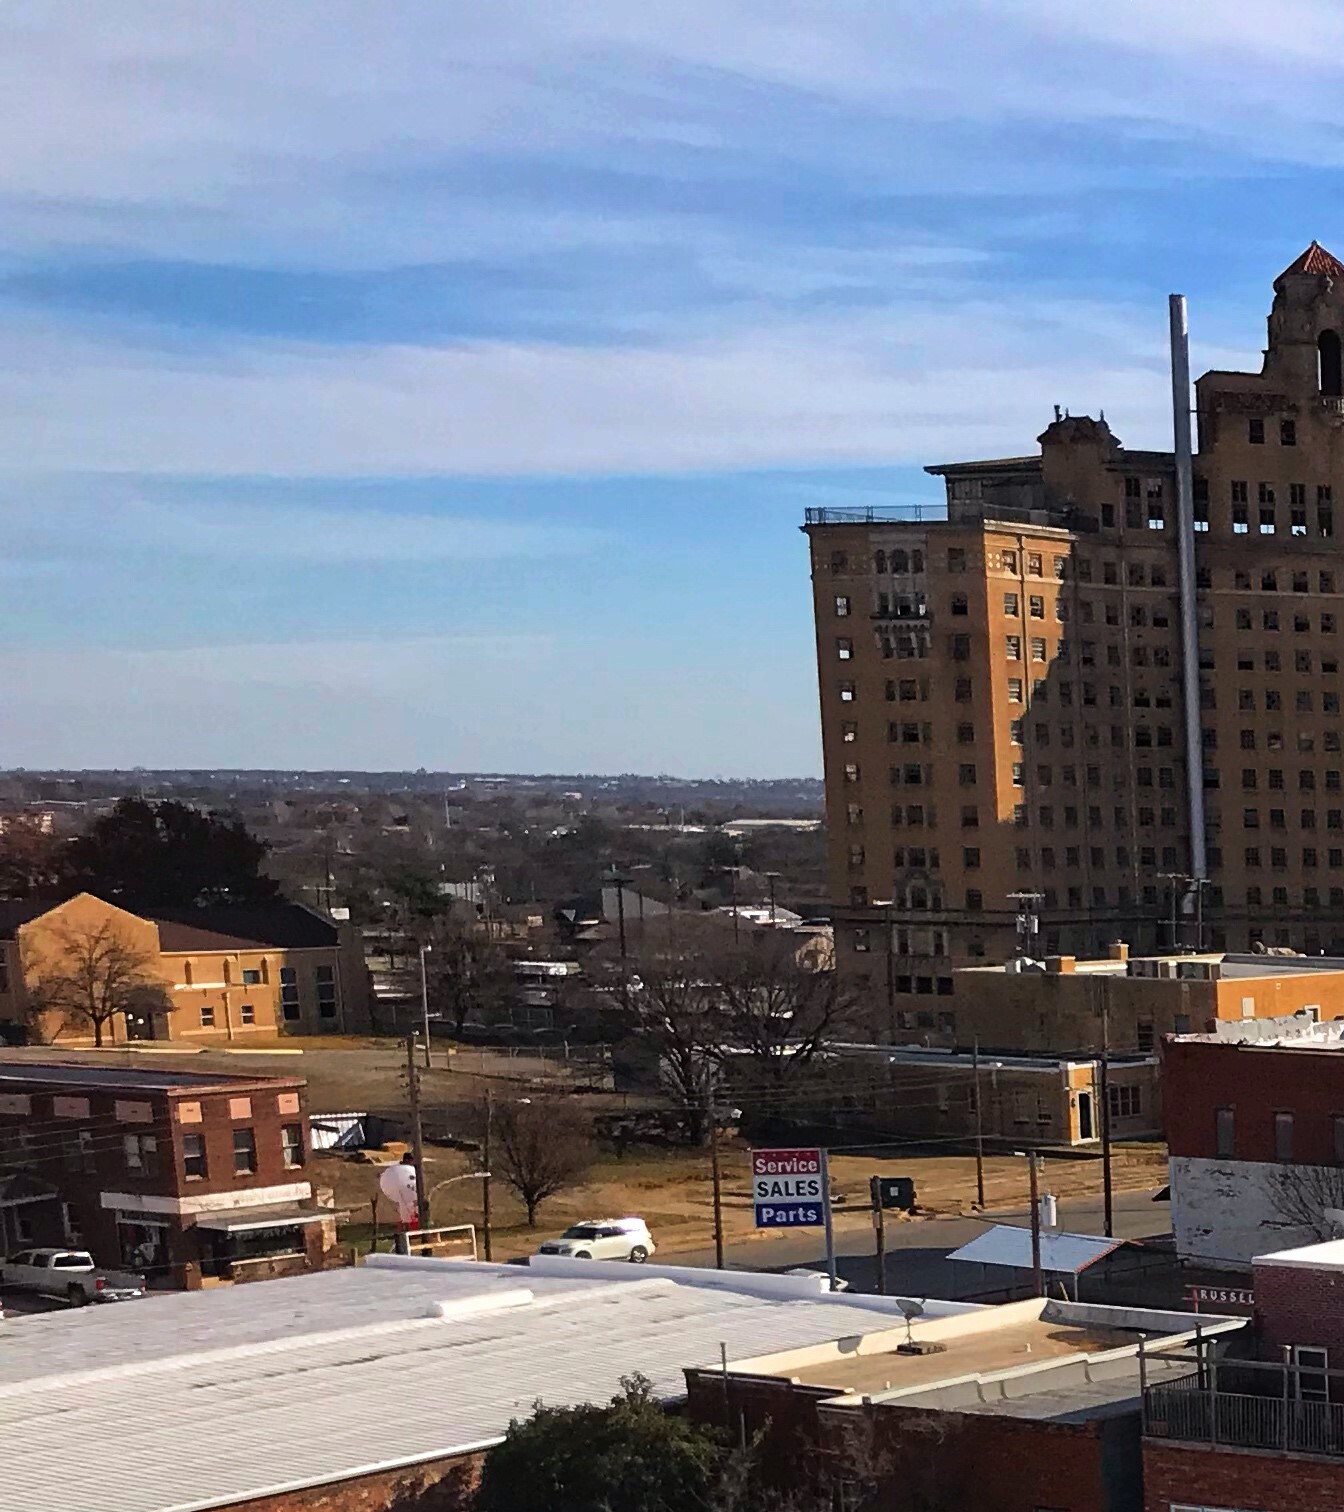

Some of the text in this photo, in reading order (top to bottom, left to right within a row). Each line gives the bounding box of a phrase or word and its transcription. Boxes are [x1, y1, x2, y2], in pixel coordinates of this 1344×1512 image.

[755, 1158, 818, 1174] Service
[757, 1180, 820, 1198] SALES
[762, 1207, 818, 1223] Parts
[1200, 1289, 1255, 1304] RUSSEL
